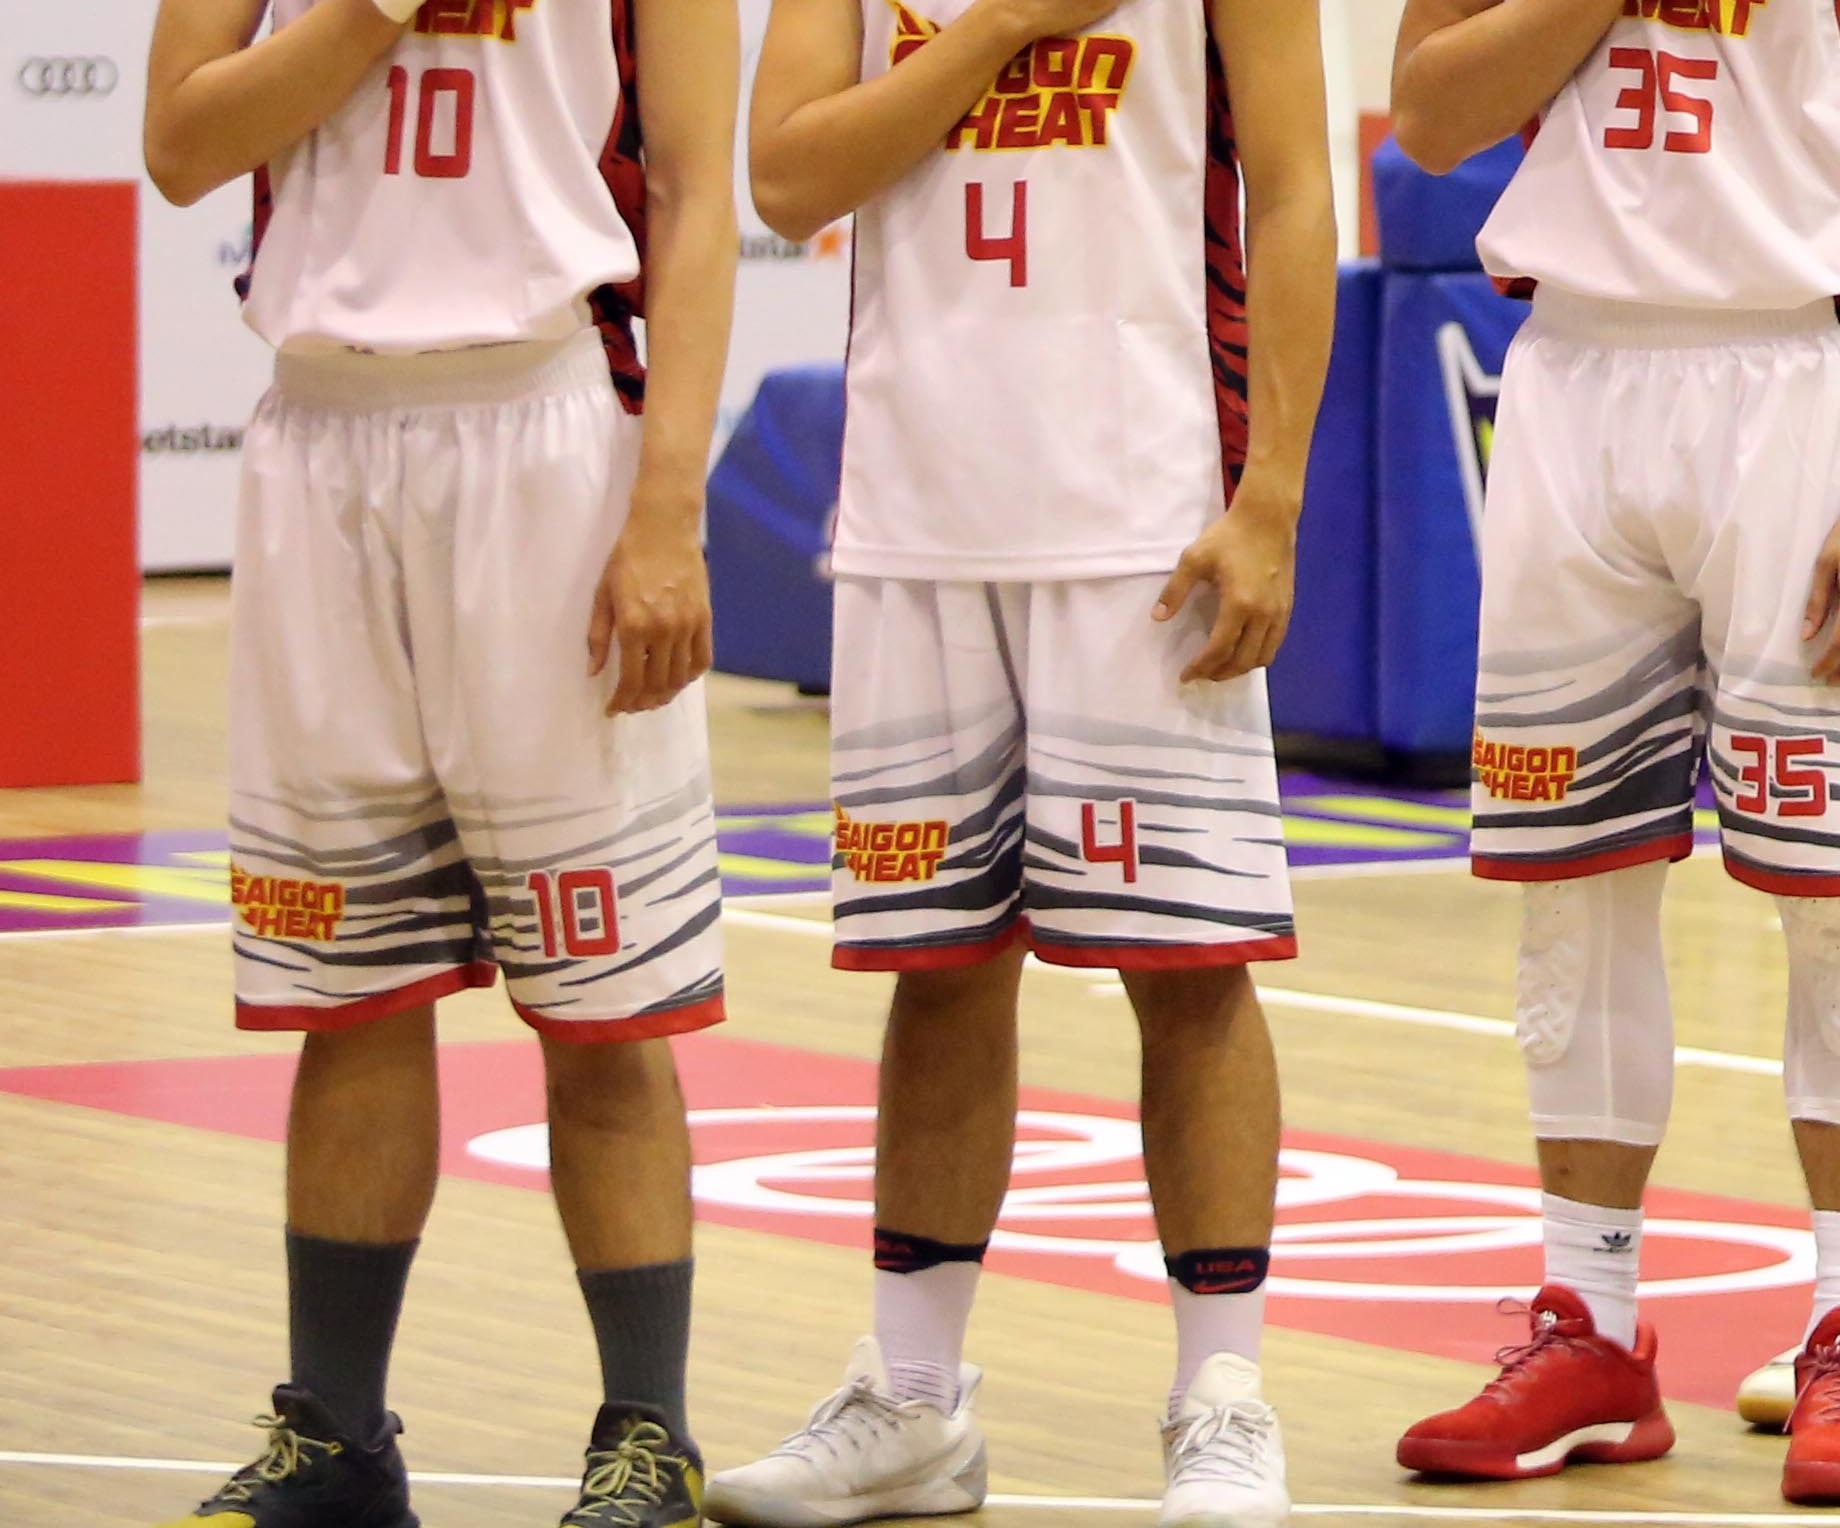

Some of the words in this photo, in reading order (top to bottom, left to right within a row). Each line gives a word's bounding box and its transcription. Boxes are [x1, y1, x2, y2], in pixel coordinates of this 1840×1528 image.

[383, 65, 475, 178] 10
[946, 91, 1119, 150] HEAT
[1604, 47, 1718, 153] 35
[965, 180, 1026, 287] 4
[1473, 739, 1576, 774] SAIGON
[1490, 771, 1575, 801] HEAT
[1730, 735, 1827, 817] 35
[836, 821, 948, 852] SAIGON
[854, 850, 943, 882] HEAT
[1081, 800, 1138, 884] 4
[231, 874, 344, 913] SAIGON
[528, 867, 622, 959] 10
[256, 905, 342, 942] HEAT
